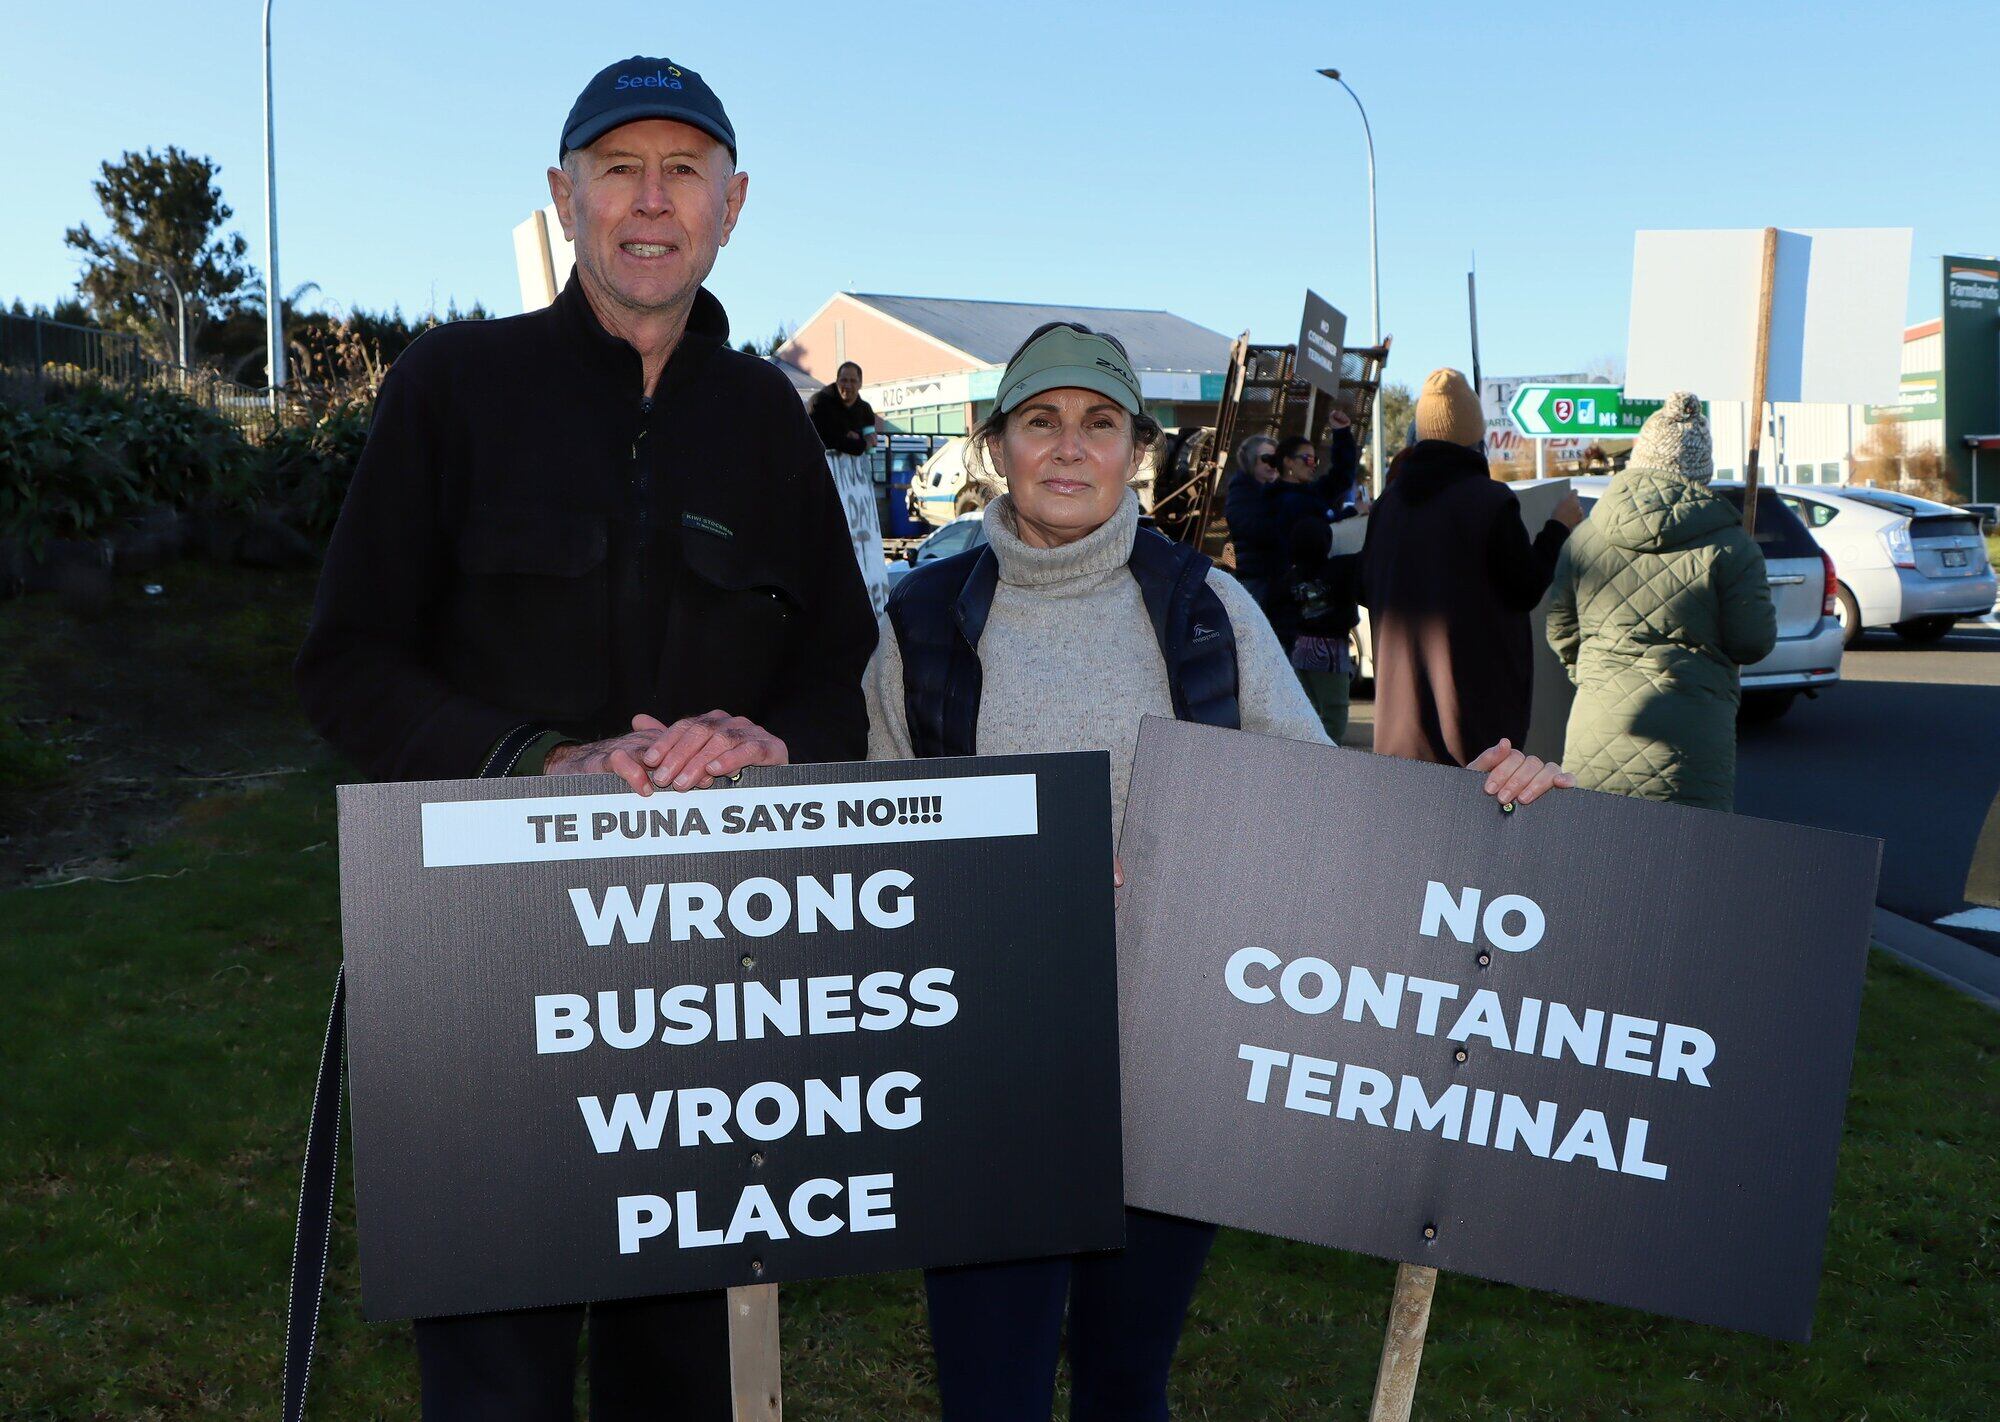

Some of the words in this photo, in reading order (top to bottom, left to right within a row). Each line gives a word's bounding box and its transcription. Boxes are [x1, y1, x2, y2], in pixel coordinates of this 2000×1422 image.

[614, 70, 683, 90] Seeka
[883, 387, 904, 407] RZG
[1558, 401, 1569, 418] 2
[1598, 411, 1618, 427] Mt
[527, 814, 578, 843] TE
[592, 808, 710, 840] PUNA
[722, 801, 825, 834] SAYS
[838, 796, 942, 828] NO!!!!
[568, 870, 915, 946] WRONG
[1420, 881, 1546, 953] NO
[535, 968, 959, 1054] BUSINESS
[1225, 947, 1716, 1087] CONTAINER
[577, 1071, 922, 1153] WRONG
[1238, 1044, 1668, 1181] TERMINAL
[618, 1173, 897, 1255] PLACE
